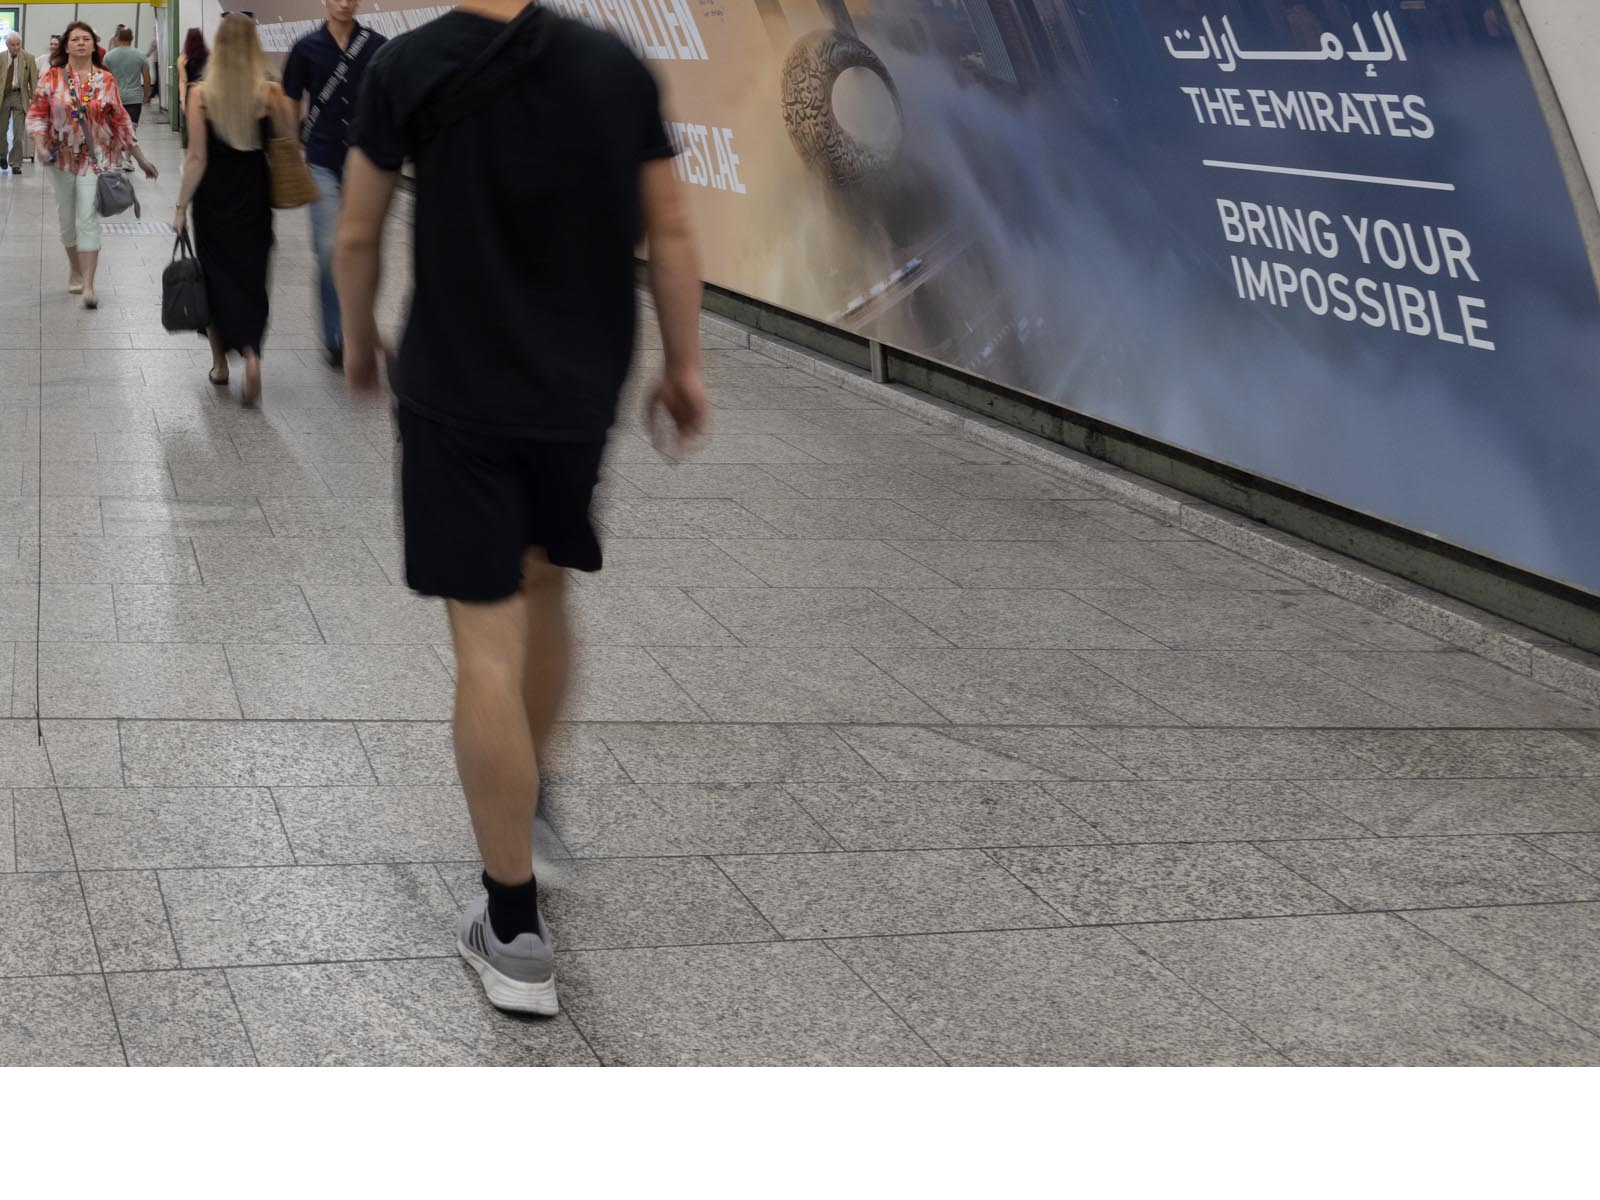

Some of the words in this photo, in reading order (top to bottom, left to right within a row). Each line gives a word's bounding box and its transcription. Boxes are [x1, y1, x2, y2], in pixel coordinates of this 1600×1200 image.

[1180, 86, 1251, 127] THE
[1247, 89, 1435, 139] EMIRATES
[664, 121, 747, 194] VEST.AE
[1216, 198, 1339, 259] BRING
[1342, 214, 1480, 282] YOUR
[1230, 255, 1496, 351] IMPOSSIBLE
